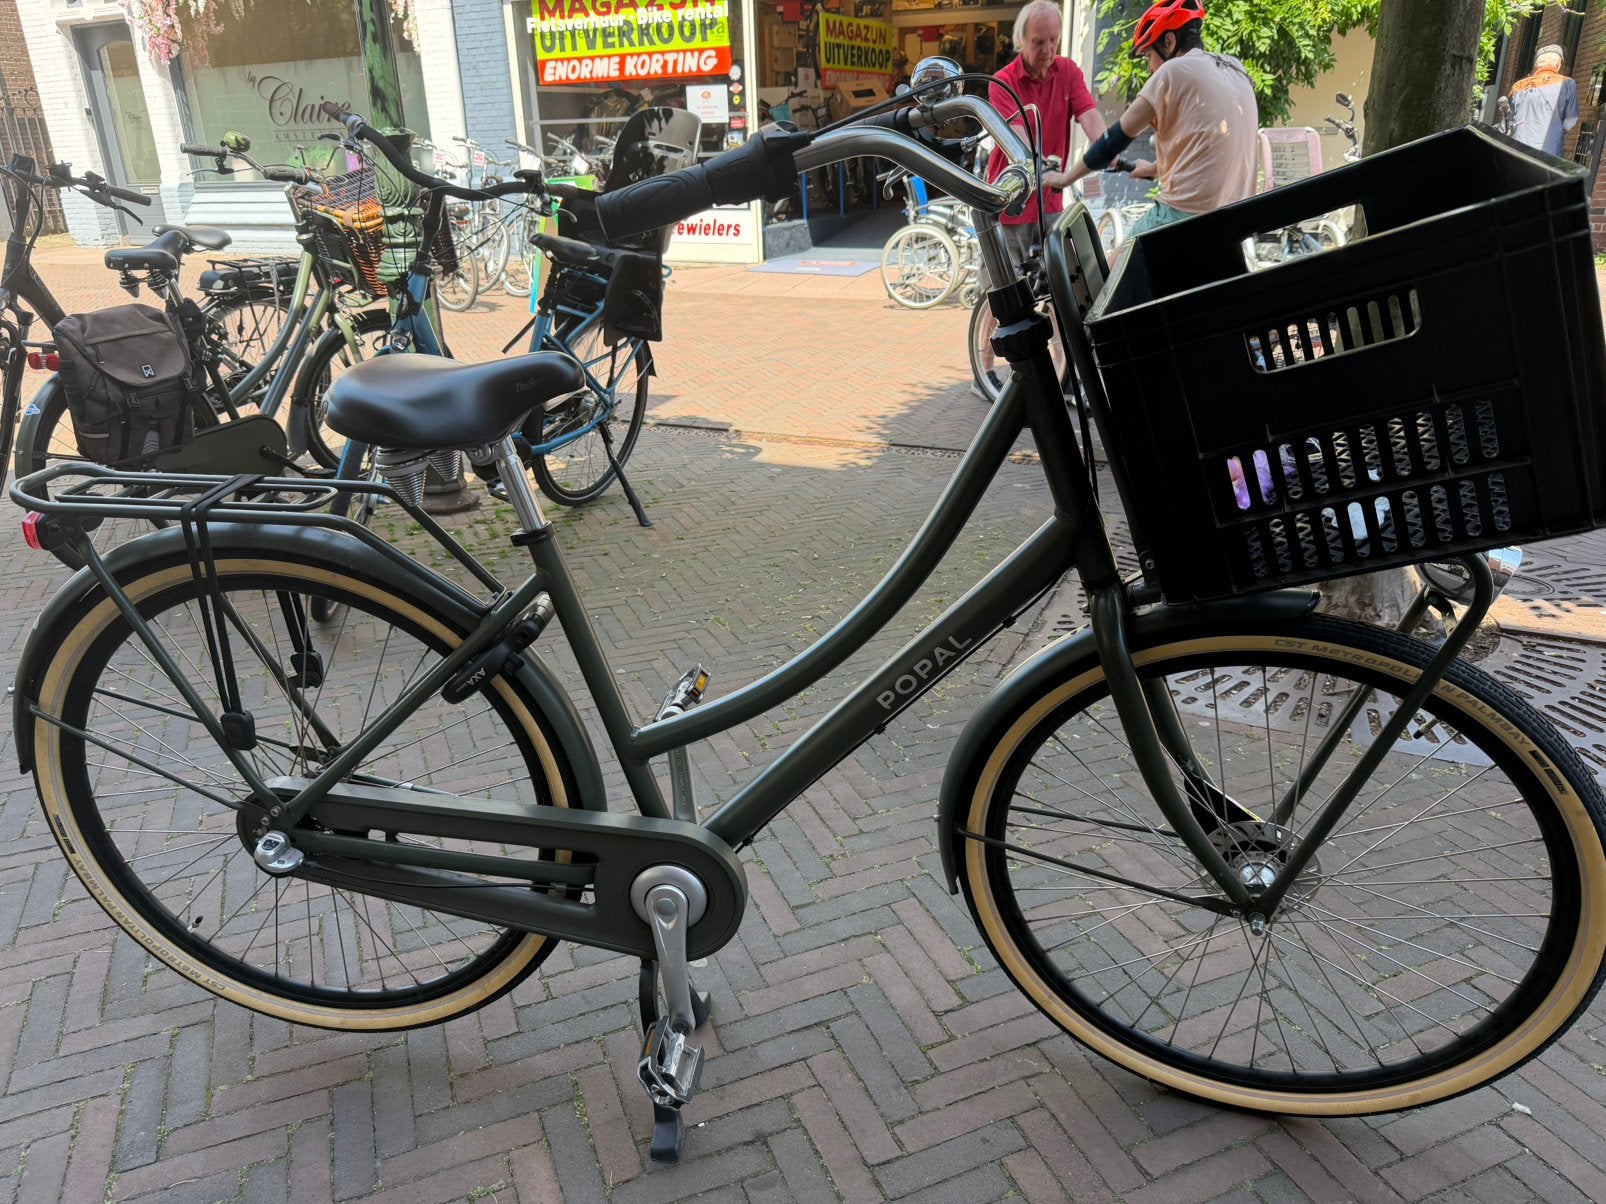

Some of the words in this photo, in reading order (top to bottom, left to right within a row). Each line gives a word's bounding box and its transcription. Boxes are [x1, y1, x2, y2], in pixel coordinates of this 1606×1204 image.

[526, 13, 625, 34] Fietsverhuur
[637, 6, 673, 25] Bike
[677, 0, 729, 21] rental
[539, 0, 716, 21] MAGA
[540, 17, 717, 53] UITVERKOOP
[543, 56, 620, 82] ENORME
[624, 49, 718, 77] KORTING
[824, 41, 891, 70] UITVERKOOP
[672, 218, 741, 237] ewielers
[465, 666, 487, 686] AXA
[876, 635, 973, 710] POPAL
[1311, 644, 1455, 693] METROPOLIN
